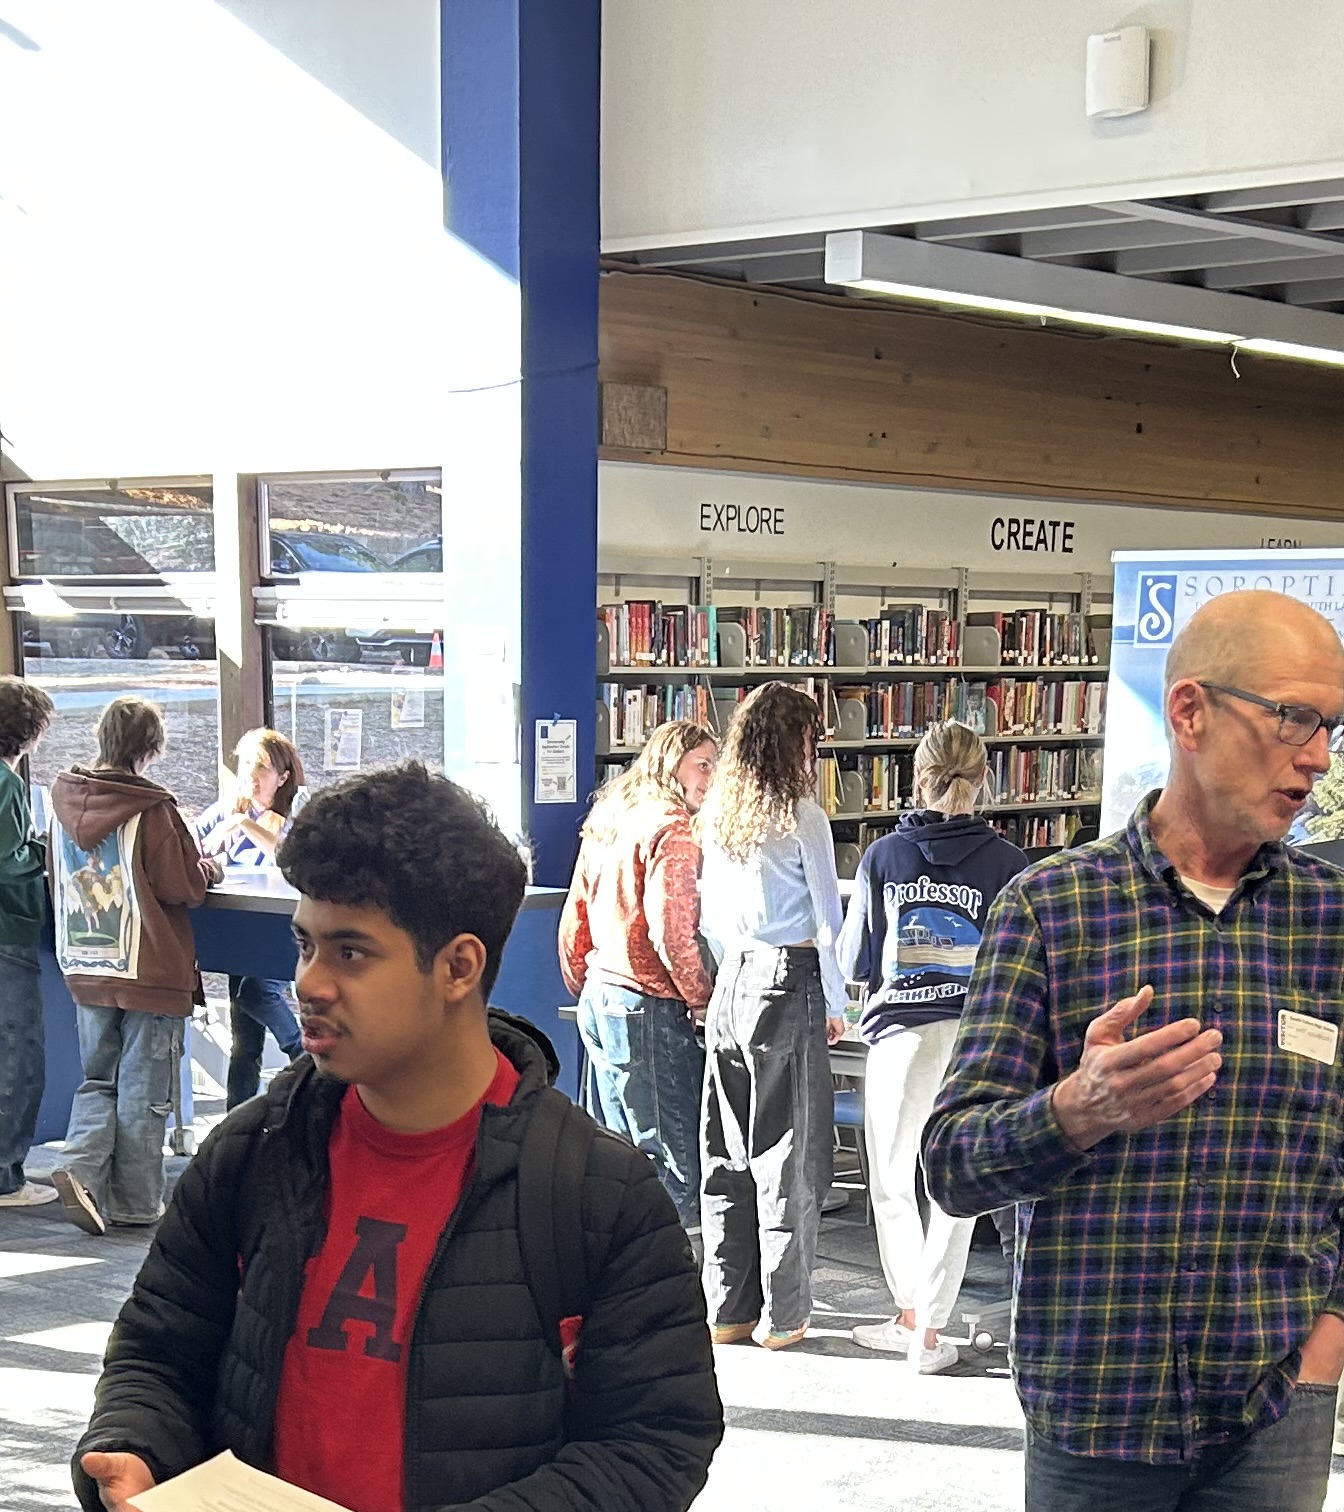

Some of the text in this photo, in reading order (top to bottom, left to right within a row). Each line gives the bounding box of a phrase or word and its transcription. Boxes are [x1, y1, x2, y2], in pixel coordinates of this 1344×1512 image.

[700, 503, 785, 534] EXPLORE
[991, 518, 1075, 553] CREATE
[308, 1215, 408, 1362] A
